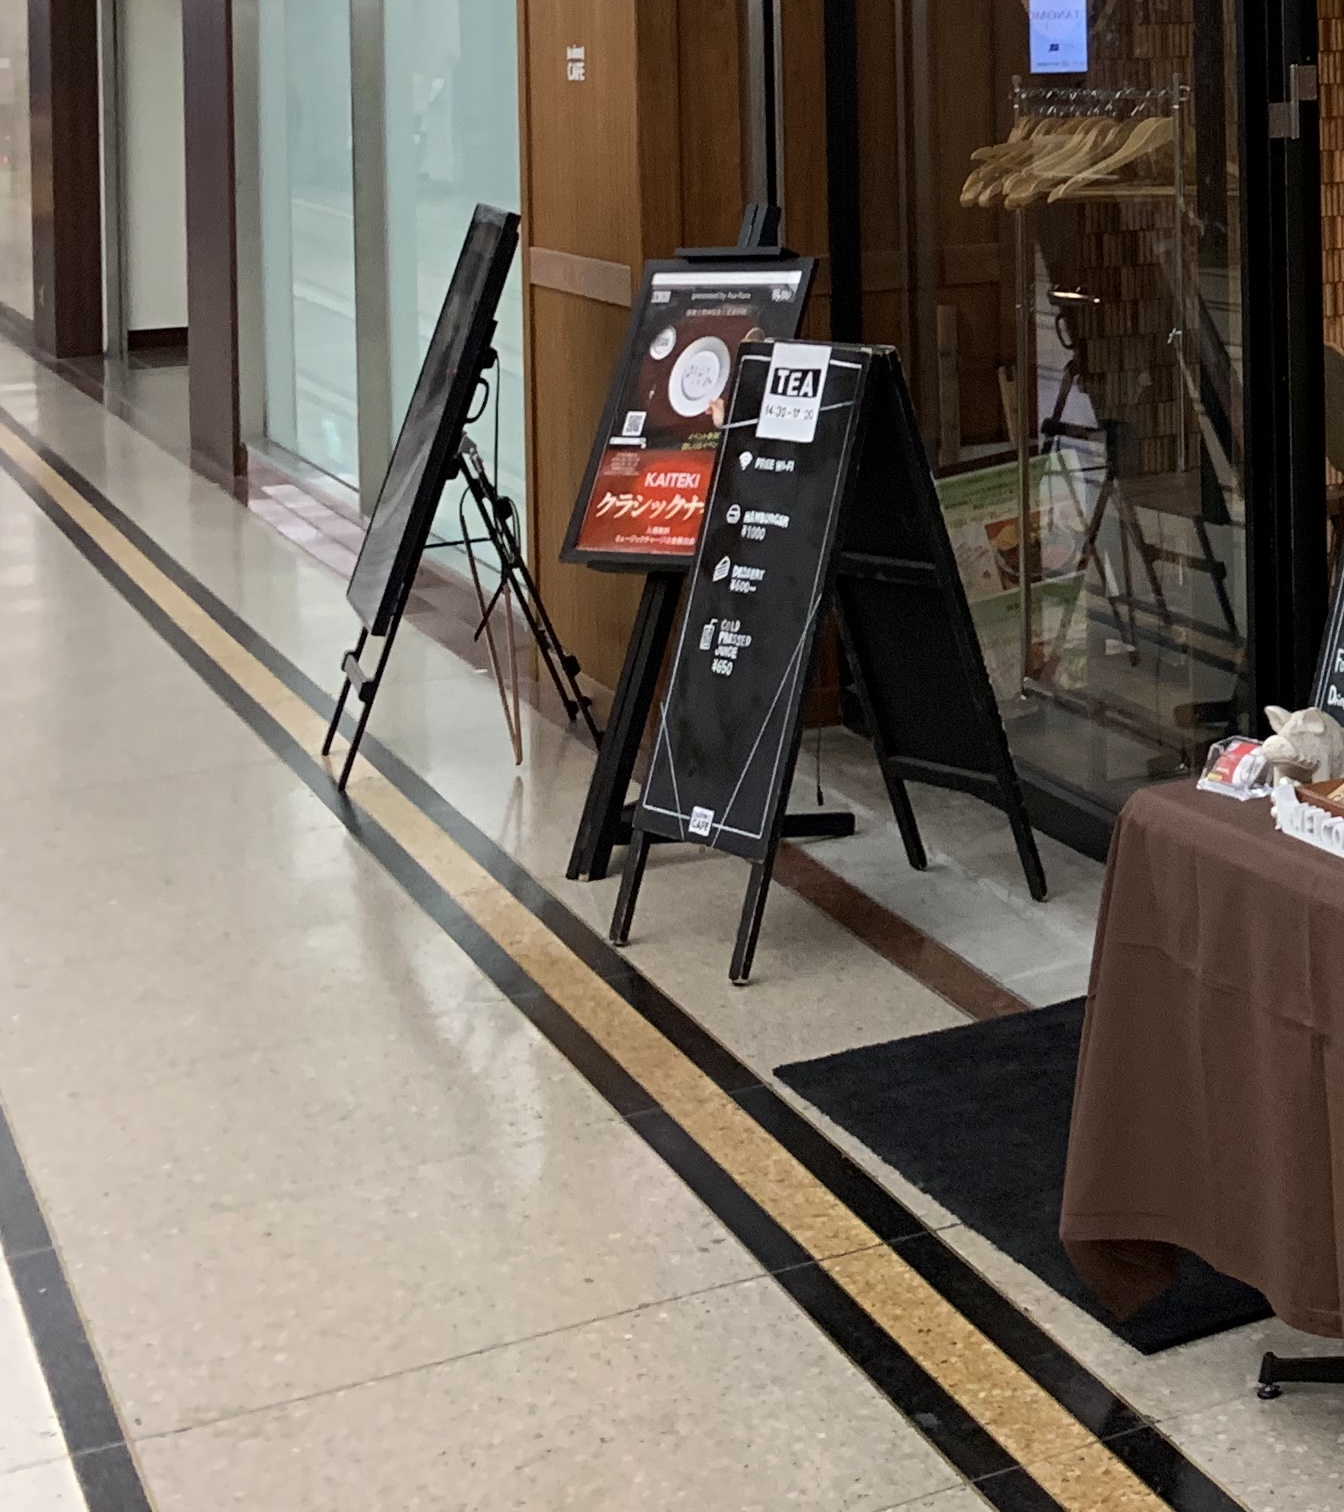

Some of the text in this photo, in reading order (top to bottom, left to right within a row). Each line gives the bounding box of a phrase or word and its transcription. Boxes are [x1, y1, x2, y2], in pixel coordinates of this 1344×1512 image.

[777, 369, 814, 398] TEA
[644, 472, 701, 489] KAITEKI
[743, 510, 790, 528] HAMBURGER
[732, 564, 766, 581] DESSERT
[720, 618, 741, 633] COLD
[714, 645, 739, 659] JUICE
